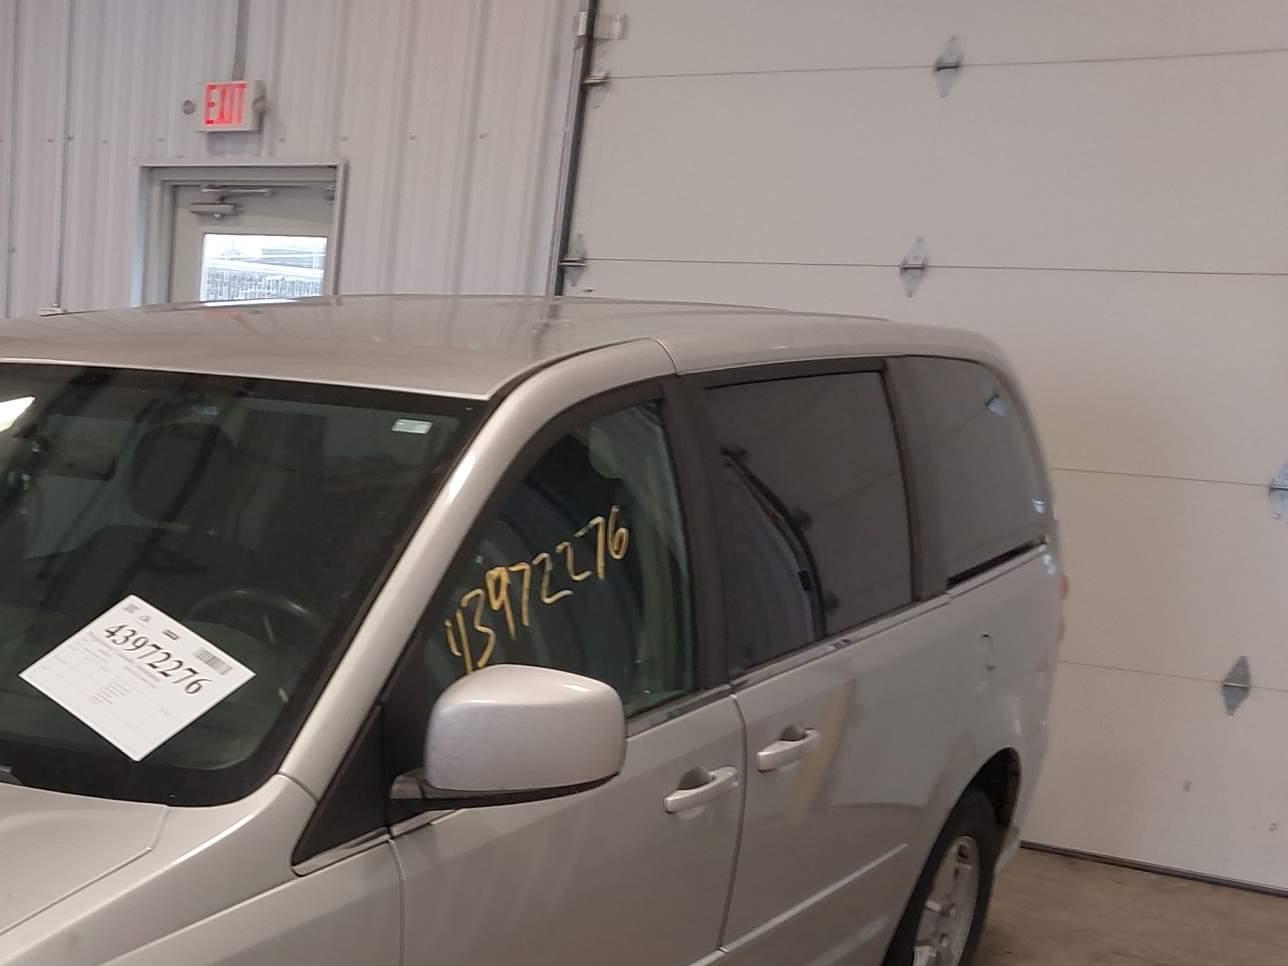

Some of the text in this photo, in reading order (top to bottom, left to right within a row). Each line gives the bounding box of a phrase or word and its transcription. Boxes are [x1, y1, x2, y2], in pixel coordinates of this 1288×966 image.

[204, 82, 248, 125] EXIT
[445, 505, 629, 675] 43972276
[103, 623, 213, 696] 43972276
